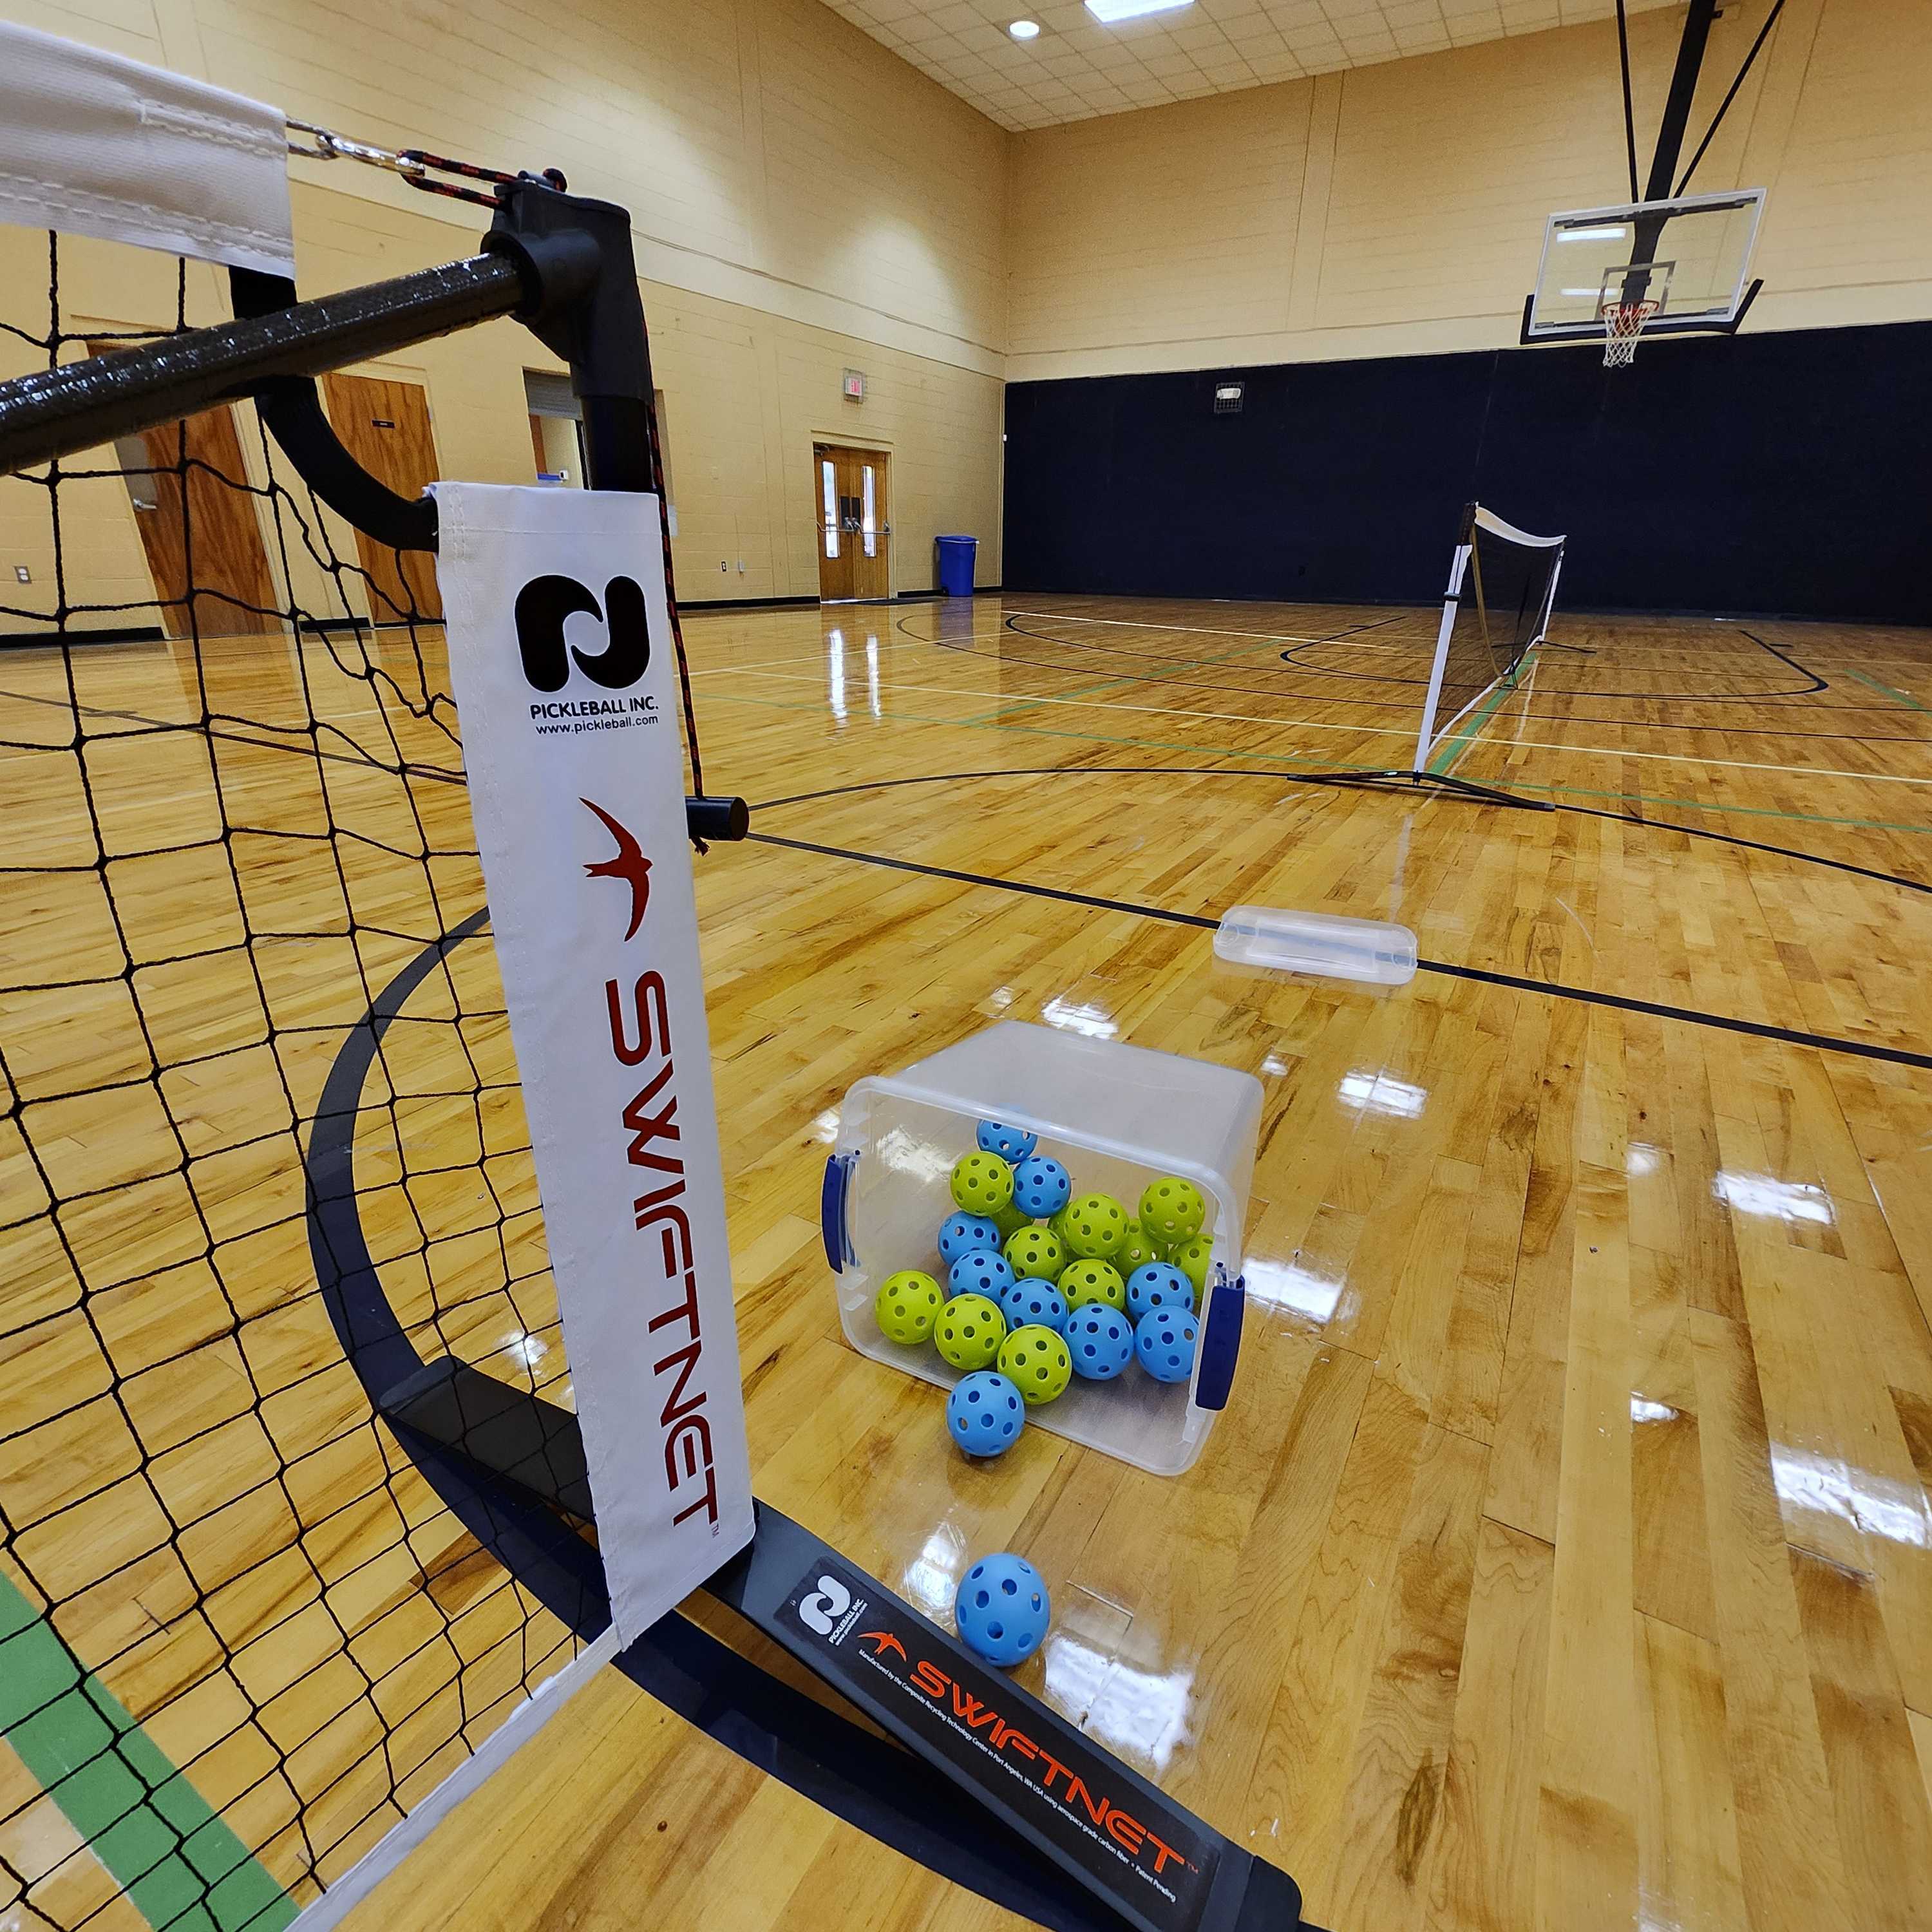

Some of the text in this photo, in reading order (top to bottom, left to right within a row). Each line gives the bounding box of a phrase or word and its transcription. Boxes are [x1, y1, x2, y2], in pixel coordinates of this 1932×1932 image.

[530, 696, 659, 719] PICKLEBALL INC.
[536, 715, 658, 735] www.pickleball.com
[605, 971, 718, 1527] SWIFTNET
[828, 1610, 856, 1643] PICKLEBALL
[858, 1649, 889, 1675] Manufactured
[887, 1671, 895, 1680] by
[893, 1676, 902, 1685] the
[902, 1682, 926, 1704] Composite
[925, 1700, 948, 1721] Recycling
[946, 1716, 973, 1741] Technology
[972, 1737, 989, 1752] Center
[992, 1753, 1004, 1765] Port
[1024, 1777, 1033, 1788] WA
[1032, 1785, 1044, 1797] USA
[1043, 1794, 1058, 1809] using
[1057, 1806, 1083, 1828] aerospace
[1083, 1824, 1099, 1840] grade
[1098, 1837, 1117, 1854] carbon
[1116, 1850, 1130, 1864] fiber
[1135, 1865, 1153, 1884] Patent
[1153, 1880, 1176, 1903] Pending
[909, 1660, 1186, 1873] SWIFTNET
